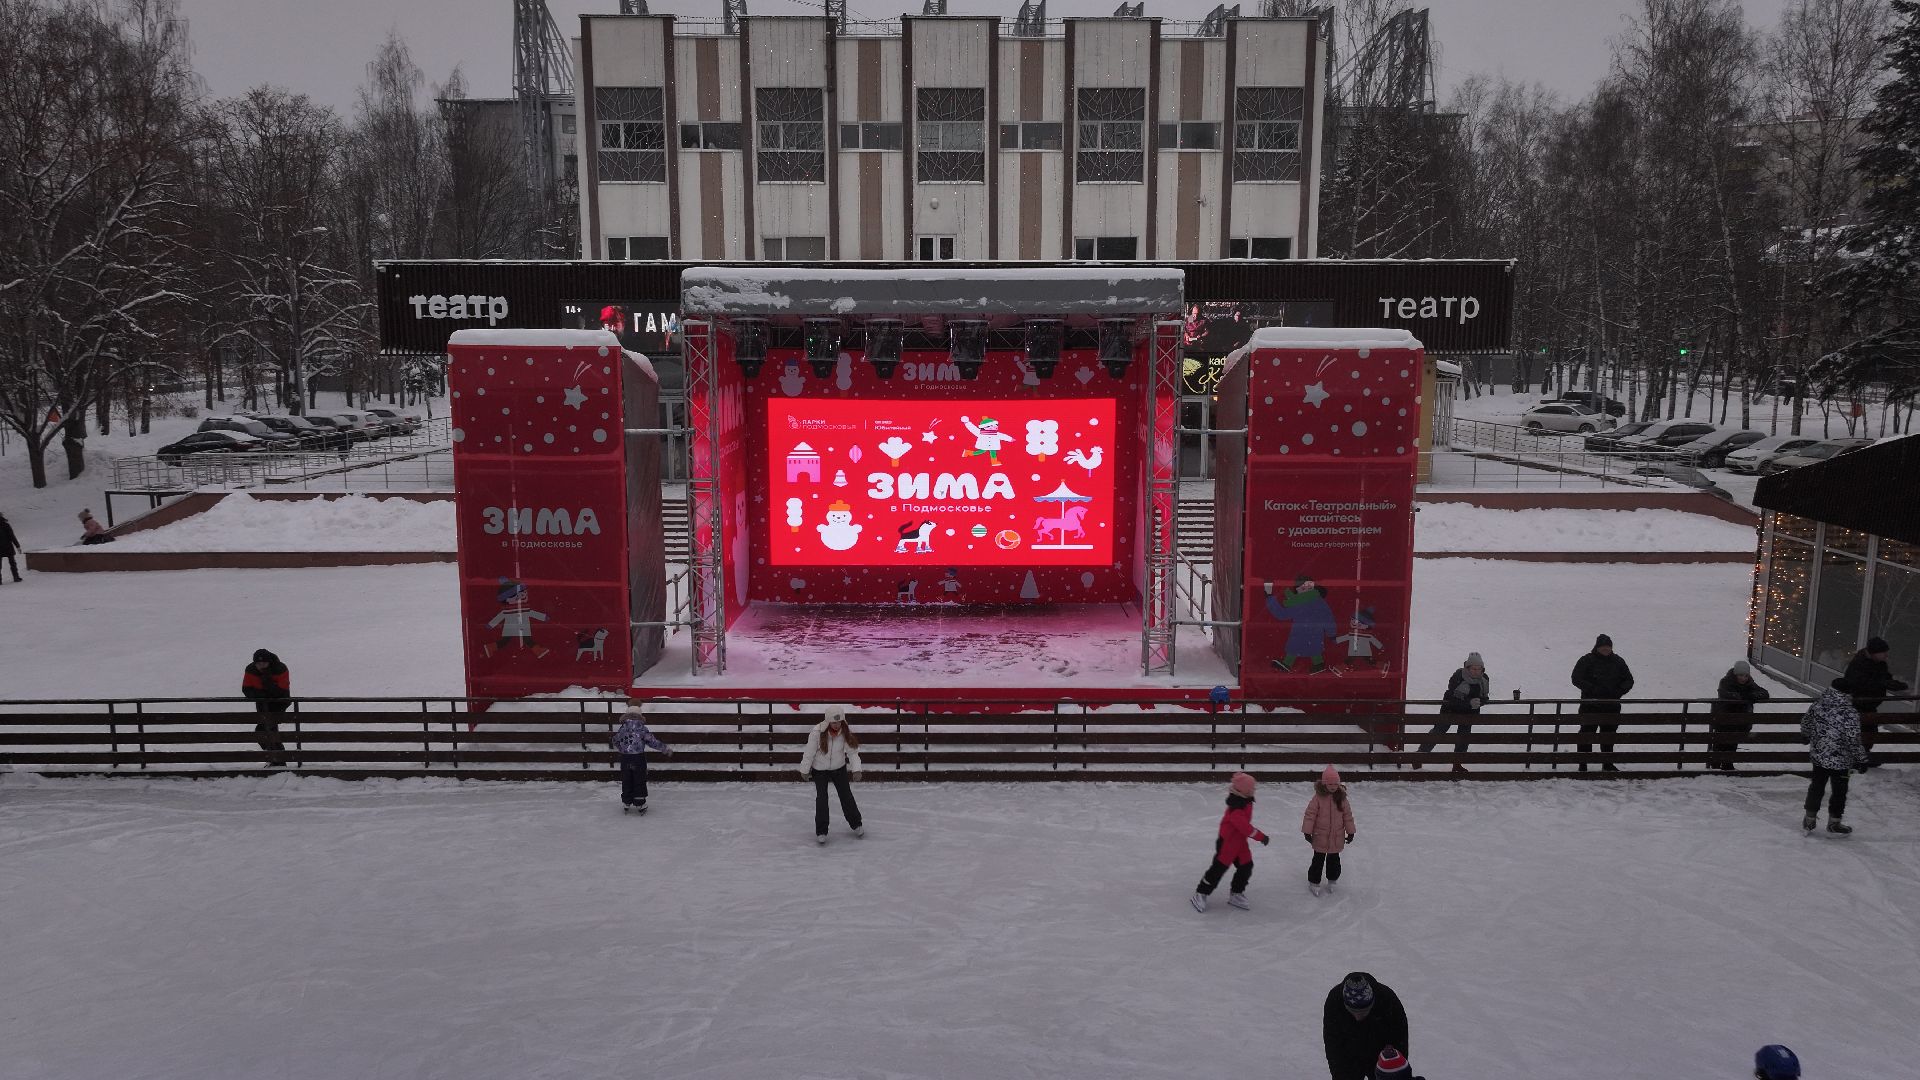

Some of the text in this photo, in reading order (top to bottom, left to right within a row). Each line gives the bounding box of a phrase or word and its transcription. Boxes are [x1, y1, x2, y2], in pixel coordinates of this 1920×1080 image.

[409, 294, 509, 326] театр
[565, 305, 582, 314] 14+
[1379, 296, 1480, 324] театр
[903, 362, 978, 382] ЗИМ
[867, 472, 1016, 500] ЗИМА
[890, 503, 992, 513] в Подмосковье
[482, 506, 601, 536] ЗИМА
[1299, 512, 1362, 523] катайтесь
[1277, 526, 1382, 538] с удовольствием
[511, 539, 583, 549] Подмосковье
